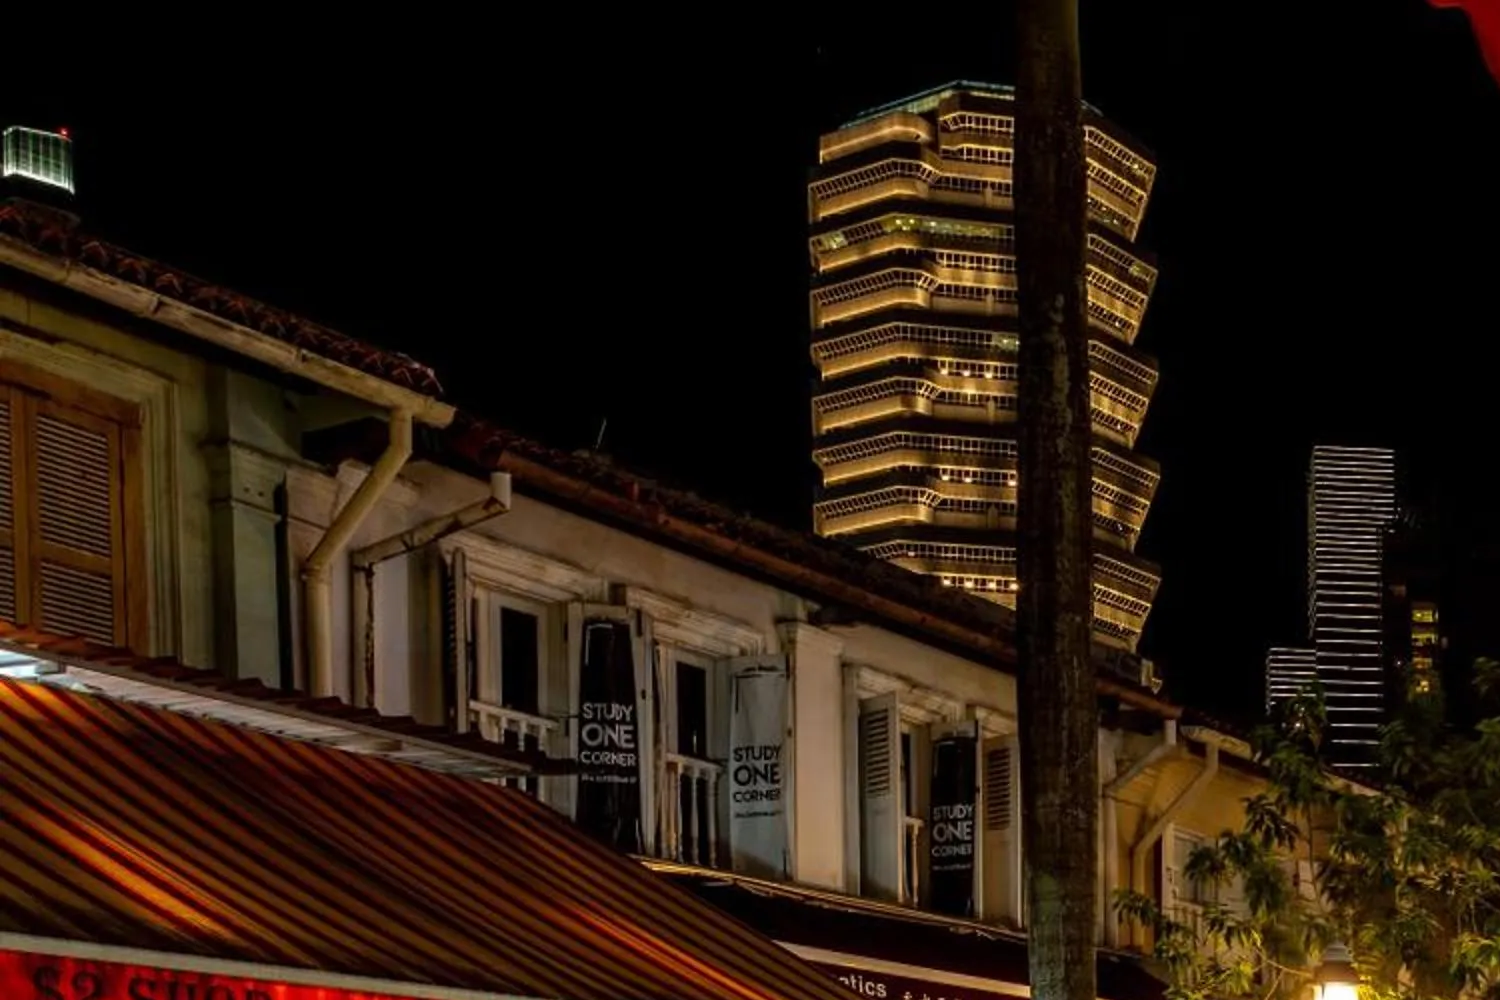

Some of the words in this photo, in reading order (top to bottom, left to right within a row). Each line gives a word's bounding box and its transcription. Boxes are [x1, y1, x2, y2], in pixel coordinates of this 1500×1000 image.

[581, 702, 634, 721] STUDY
[581, 722, 635, 749] ONE
[579, 751, 636, 767] CORNER
[733, 744, 782, 763] STUDY
[733, 764, 780, 787] ONE
[733, 789, 781, 804] CORNER
[933, 803, 975, 820] STUDY
[933, 821, 973, 842] ONE
[931, 843, 973, 857] CORNER
